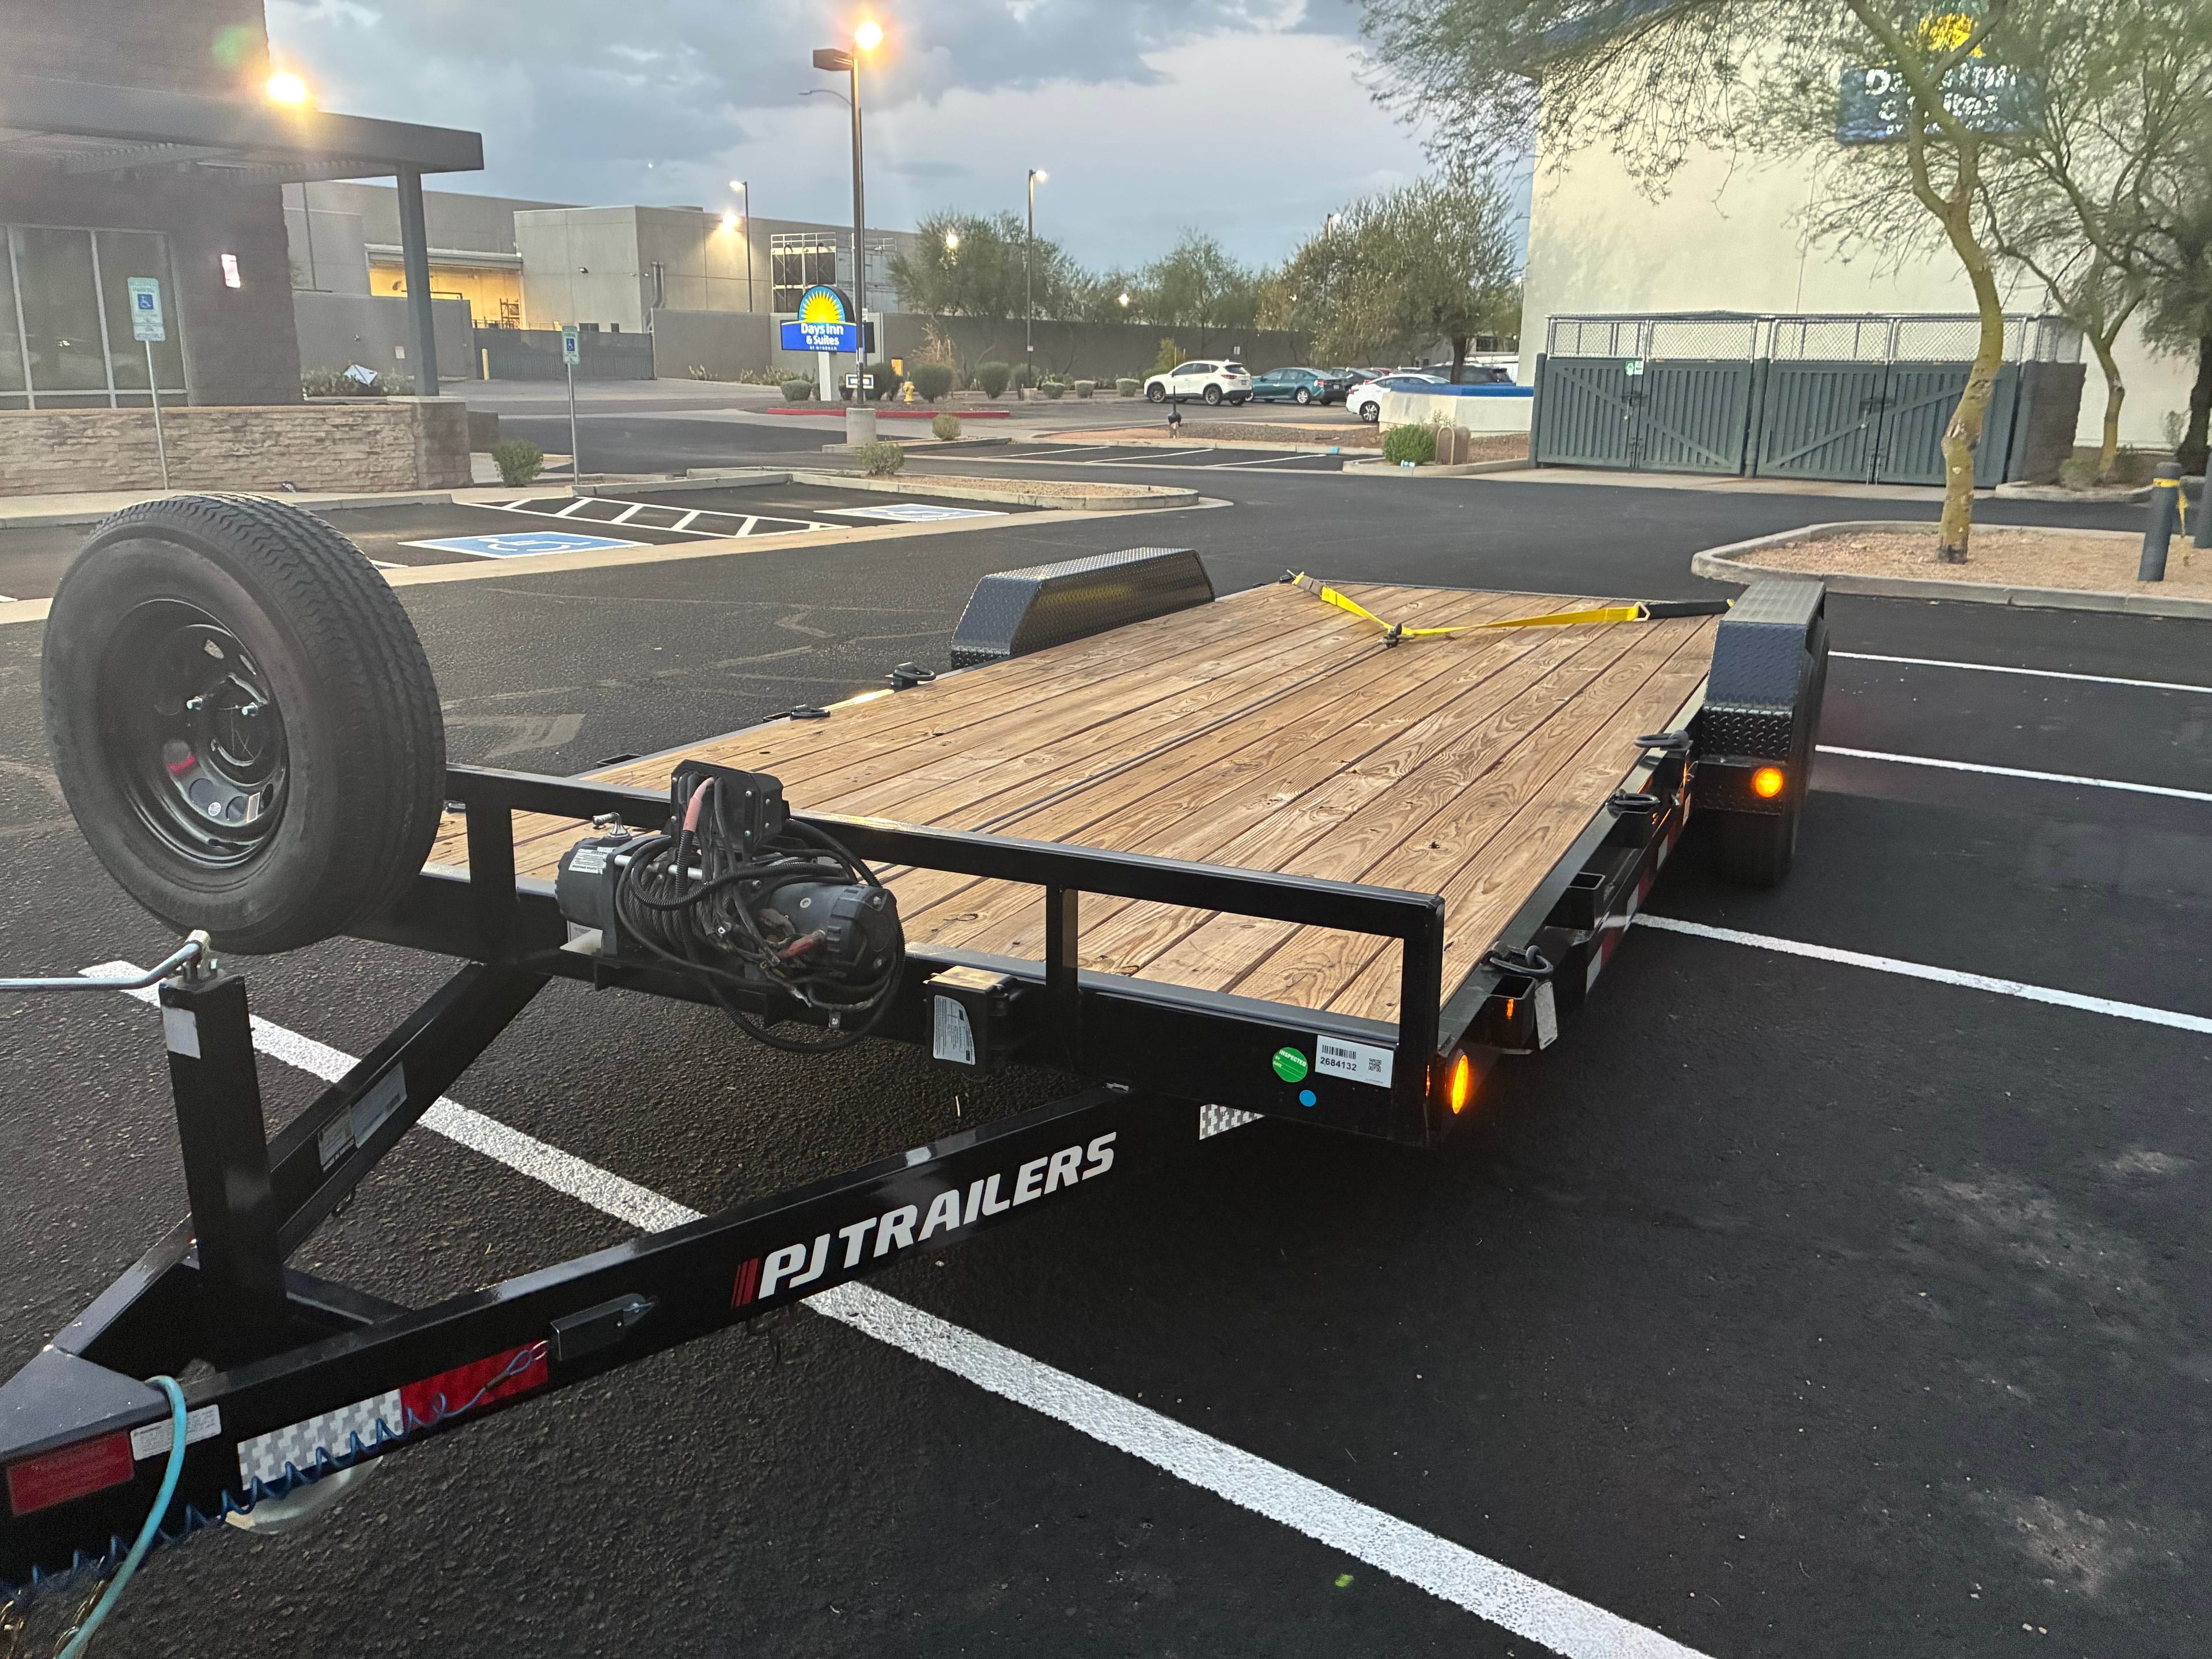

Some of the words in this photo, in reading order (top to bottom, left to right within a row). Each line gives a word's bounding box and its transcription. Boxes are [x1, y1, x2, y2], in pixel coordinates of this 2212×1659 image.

[801, 323, 825, 335] Days
[826, 323, 844, 335] Inn
[813, 335, 840, 345] Suites
[1279, 1049, 1307, 1067] INSPECTED
[1320, 1056, 1357, 1071] 2684132
[757, 1233, 831, 1300] PJ
[839, 1131, 1118, 1269] TRAILERS
